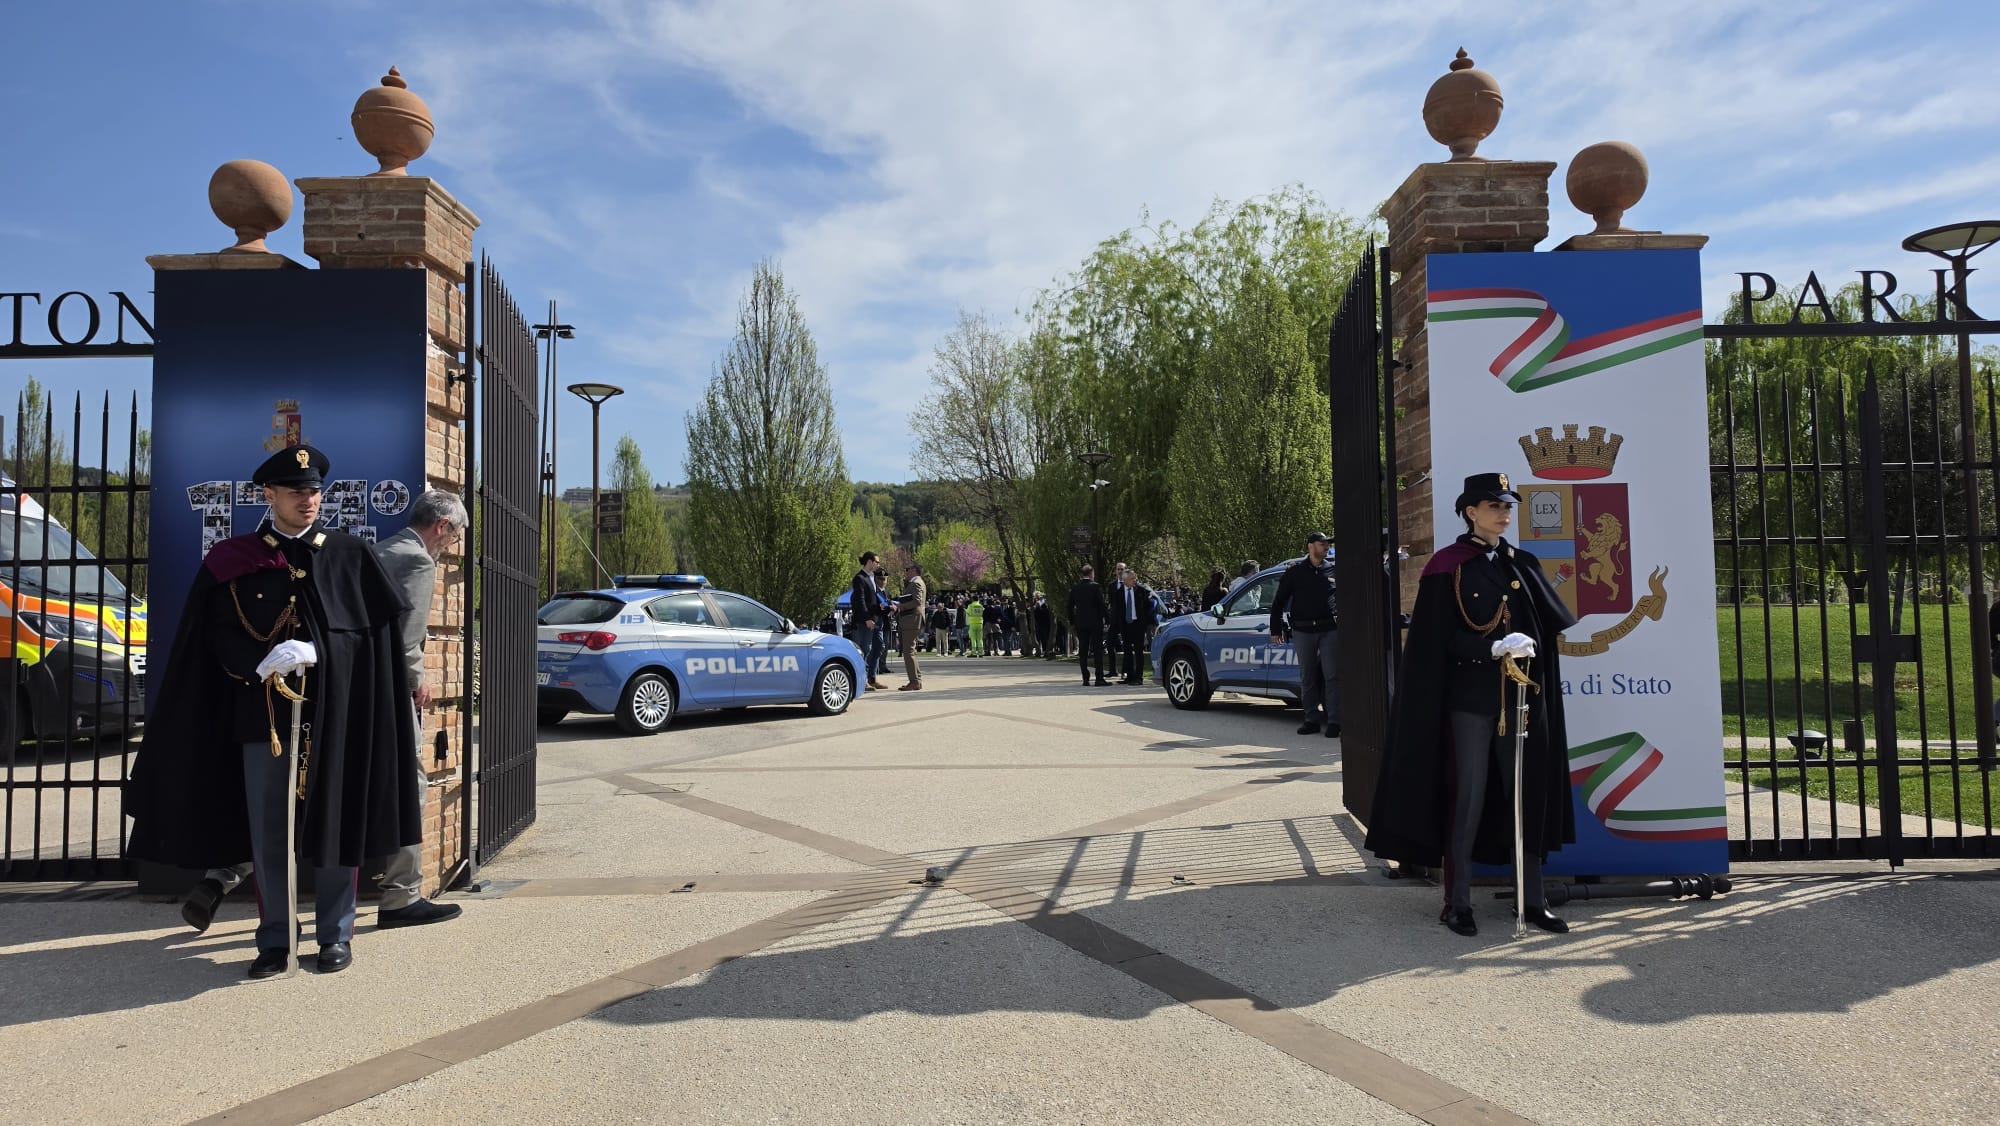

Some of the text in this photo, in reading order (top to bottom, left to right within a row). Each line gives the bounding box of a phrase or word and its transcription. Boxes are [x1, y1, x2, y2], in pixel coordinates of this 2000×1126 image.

[1734, 268, 1988, 324] PARK
[0, 291, 154, 346] TON
[1535, 503, 1558, 515] LEX
[620, 614, 645, 625] 113
[1608, 599, 1650, 640] LIBERTAS
[1561, 643, 1596, 654] LEGE
[686, 655, 800, 676] POLIZIA
[1580, 674, 1604, 695] di
[1611, 673, 1672, 695] Stato
